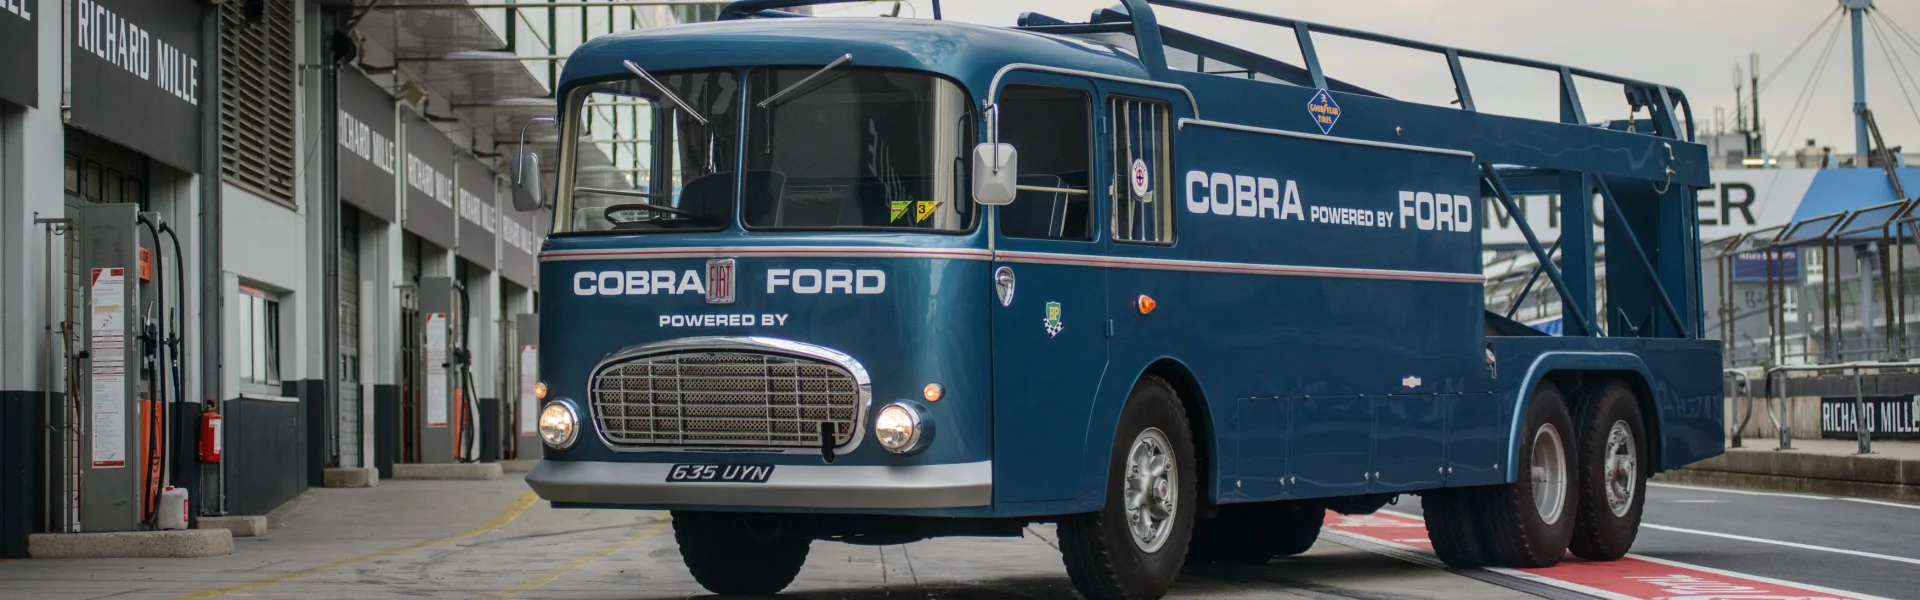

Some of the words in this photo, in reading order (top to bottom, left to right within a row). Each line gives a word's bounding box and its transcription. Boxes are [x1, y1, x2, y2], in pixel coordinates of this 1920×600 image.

[77, 0, 150, 81] RICHARD
[156, 38, 198, 106] MILLE
[918, 204, 926, 214] 3
[1185, 170, 1305, 221] COBRA
[1310, 205, 1374, 227] POWERED
[1377, 211, 1394, 228] BY
[1398, 190, 1473, 233] FORD
[573, 269, 706, 296] COBRA
[766, 268, 886, 294] FORD
[709, 265, 731, 297] FIAT
[659, 314, 756, 327] POWERED
[761, 313, 789, 326] BY
[1049, 306, 1059, 320] BP
[672, 464, 719, 480] 635
[722, 465, 770, 481] UYN
